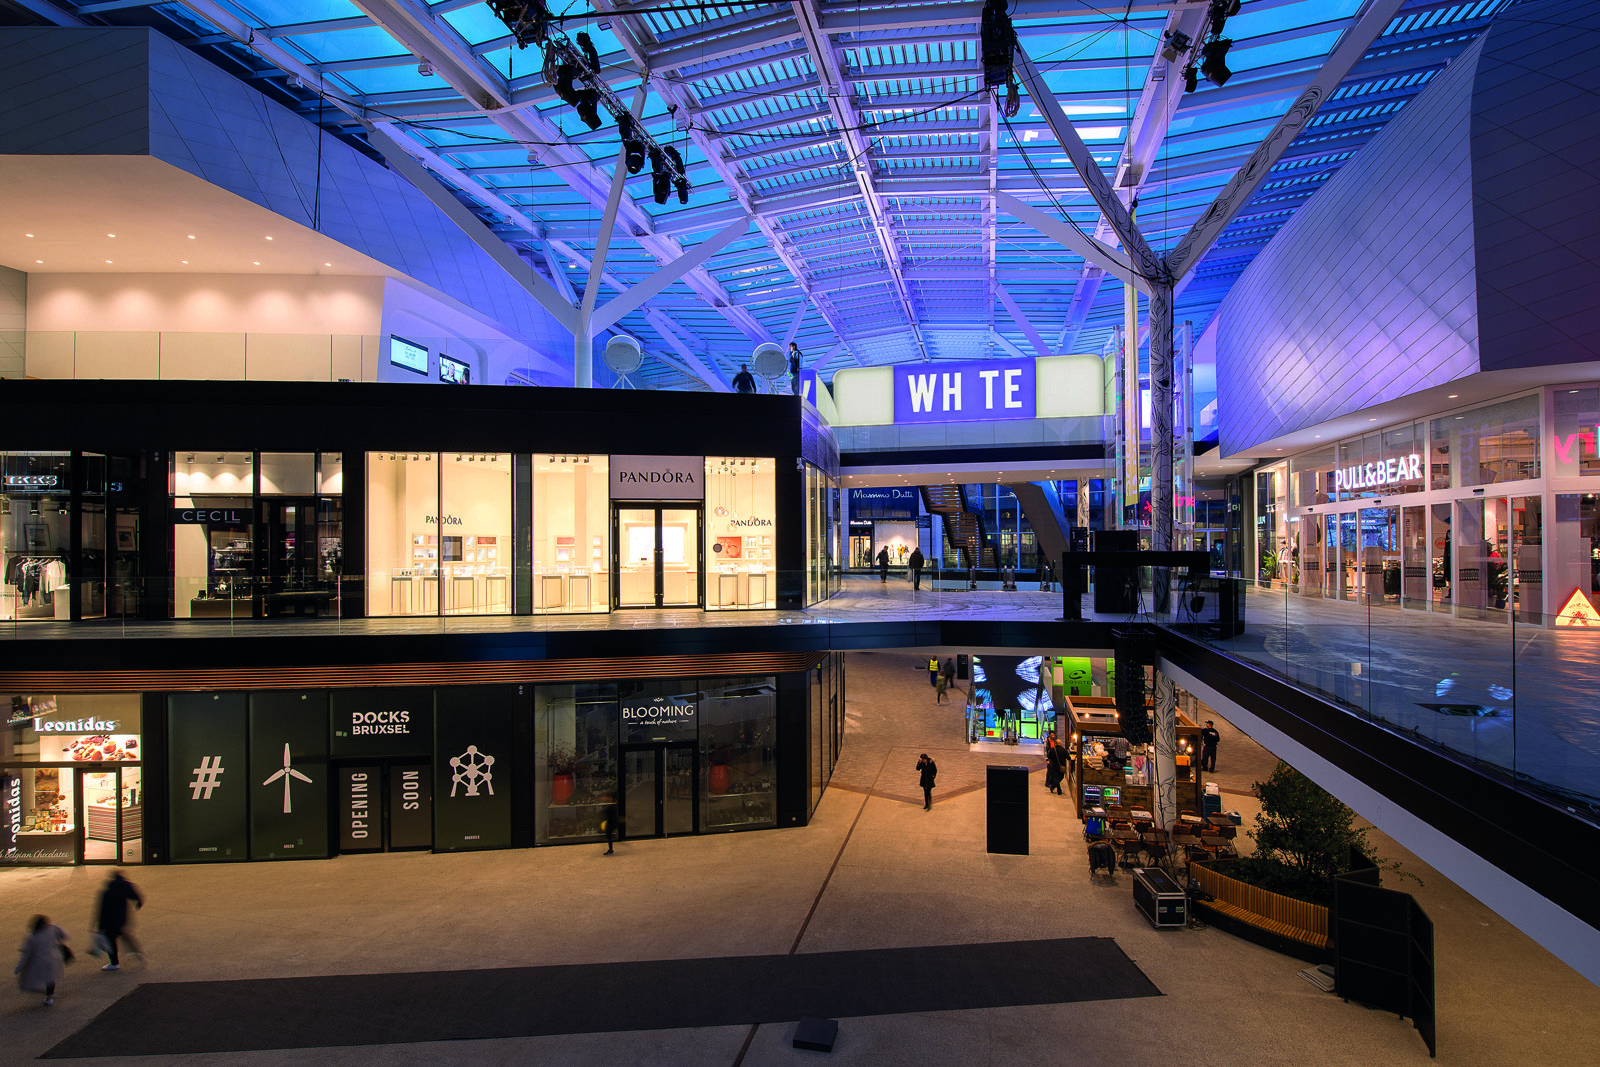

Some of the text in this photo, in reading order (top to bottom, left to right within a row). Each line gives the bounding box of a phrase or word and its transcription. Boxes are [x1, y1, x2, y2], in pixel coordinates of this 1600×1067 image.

[619, 468, 695, 483] PANDORA
[1335, 454, 1423, 492] PULL&BEAR
[853, 489, 914, 499] Massimo Dutti
[181, 510, 241, 522] CECIL
[352, 711, 410, 724] DOCKS
[622, 705, 694, 719] BLOOMING
[34, 717, 115, 732] Leonidas
[352, 724, 410, 735] BRUXSEL
[402, 771, 419, 810] SOON
[351, 772, 369, 839] OPENING
